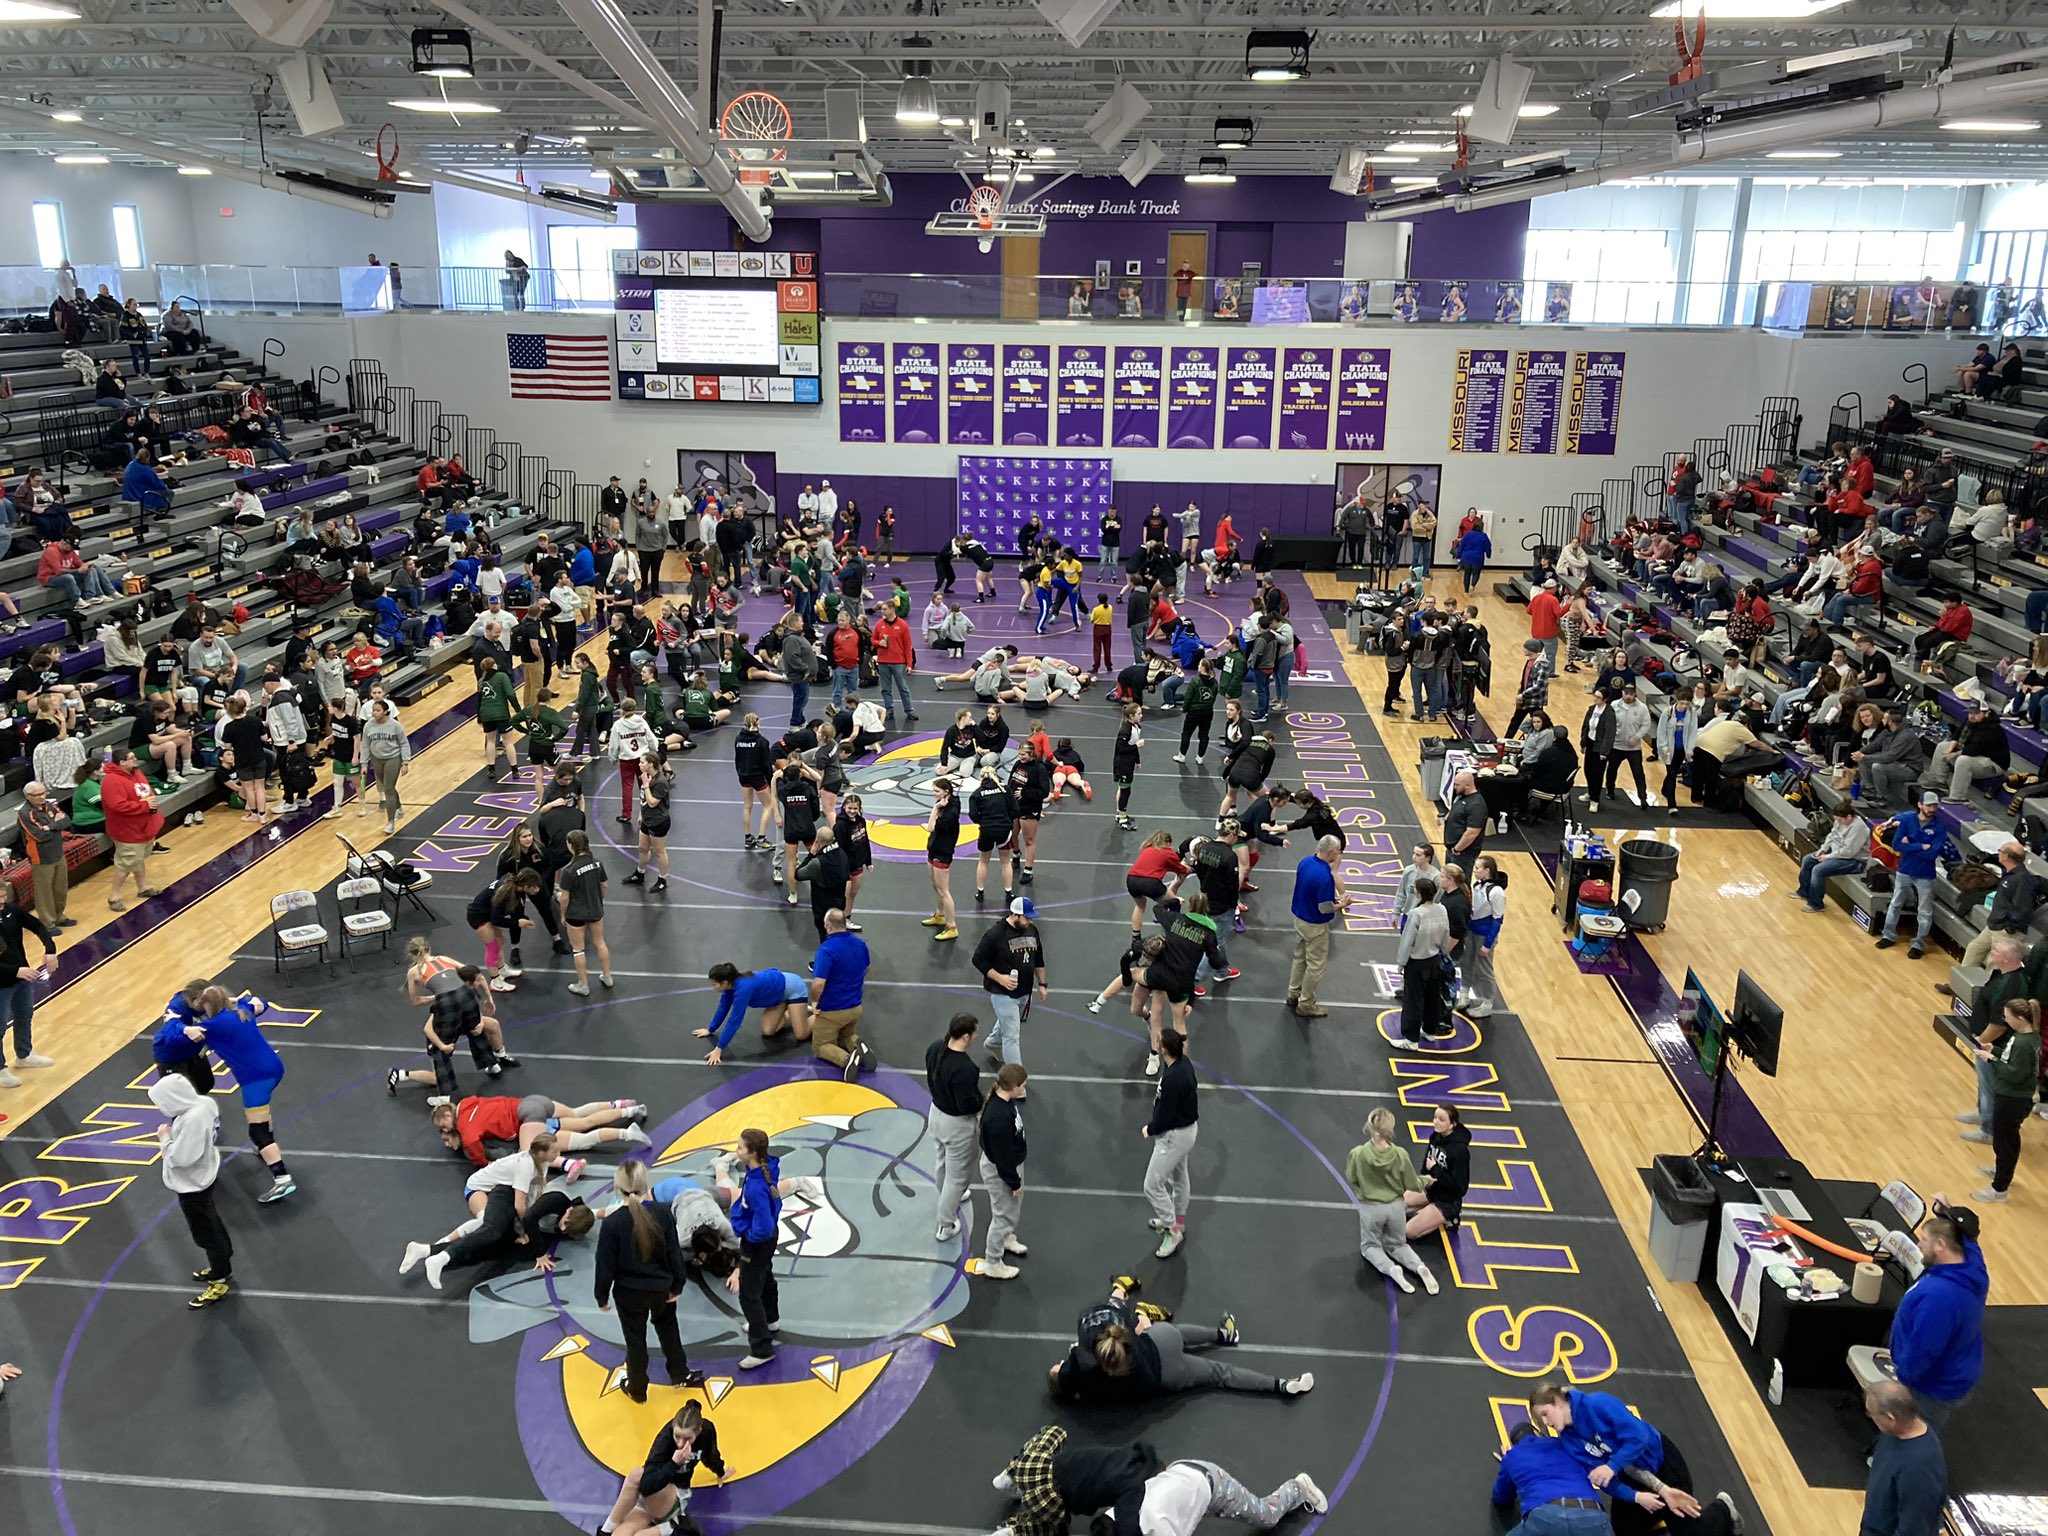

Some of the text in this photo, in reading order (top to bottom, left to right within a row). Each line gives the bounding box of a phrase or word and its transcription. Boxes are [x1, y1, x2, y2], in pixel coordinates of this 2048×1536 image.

[1040, 199, 1095, 219] Savings
[1098, 200, 1136, 215] Bank
[1139, 200, 1180, 215] Track
[667, 252, 684, 269] K
[769, 253, 786, 270] K
[795, 256, 813, 274] U
[784, 322, 813, 334] Hale's
[840, 365, 884, 374] CHAMPIONS
[1122, 362, 1154, 370] STATE
[1235, 363, 1267, 371] STATE
[1349, 364, 1381, 372] STATE
[1475, 361, 1501, 369] STATE
[1533, 362, 1560, 370] STATE
[1592, 363, 1619, 371] STATE
[894, 366, 939, 375] CHAMPIONS
[949, 367, 993, 376] CHAMPIONS
[1003, 368, 1048, 377] CHAMPIONS
[1059, 369, 1104, 378] CHAMPIONS
[1115, 370, 1160, 379] CHAMPIONS
[1171, 370, 1217, 379] CHAMPIONS
[1227, 370, 1273, 380] CHAMPIONS
[1470, 367, 1488, 375] FINAL
[1528, 368, 1547, 376] FINAL
[1587, 369, 1605, 377] FINAL
[1284, 371, 1330, 380] CHAMPIONS
[1341, 372, 1387, 380] CHAMPIONS
[674, 376, 690, 392] K
[747, 378, 765, 394] K
[1451, 351, 1470, 450] MISSOURI
[1508, 352, 1528, 452] MISSOURI
[1566, 353, 1587, 453] MISSOURI
[962, 458, 970, 467] K
[996, 459, 1005, 468] K
[1030, 460, 1039, 469] K
[1065, 461, 1074, 469] K
[1100, 461, 1108, 470] K
[979, 475, 987, 484] K
[1013, 476, 1022, 485] K
[1048, 477, 1056, 486] K
[1082, 477, 1090, 486] K
[962, 492, 970, 500] K
[996, 493, 1005, 501] K
[1030, 493, 1038, 502] K
[1064, 494, 1073, 503] K
[1099, 495, 1107, 503] K
[979, 509, 987, 517] K
[1013, 510, 1021, 518] K
[1047, 510, 1055, 519] K
[1081, 511, 1090, 520] K
[962, 525, 970, 533] K
[996, 526, 1004, 534] K
[1064, 528, 1072, 536] K
[1013, 542, 1020, 551] K
[1080, 544, 1089, 553] K
[630, 739, 639, 752] 3
[342, 882, 374, 895] KEARNEY
[276, 895, 309, 907] KEARNEY
